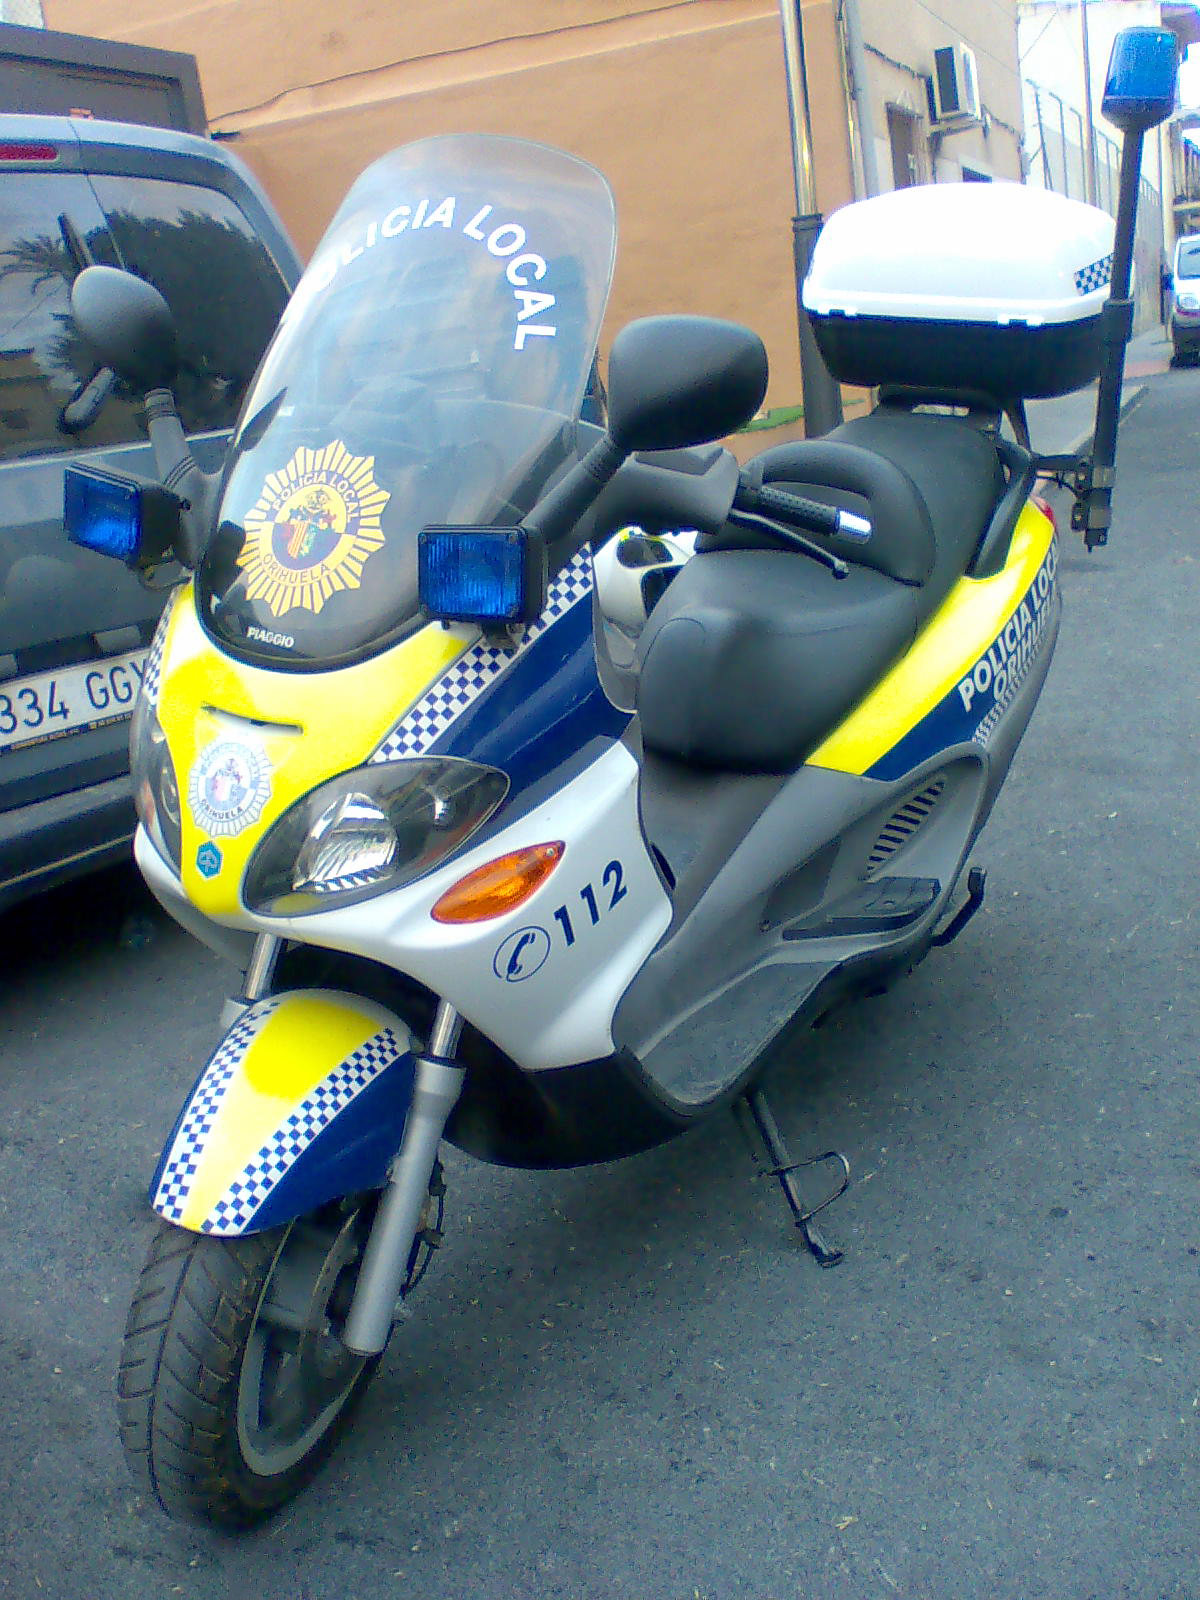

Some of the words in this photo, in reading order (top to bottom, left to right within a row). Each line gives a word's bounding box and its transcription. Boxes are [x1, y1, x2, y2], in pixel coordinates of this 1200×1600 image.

[300, 196, 456, 293] OLICIA
[462, 204, 557, 350] LOCAL
[272, 471, 327, 511] POLICIA
[329, 473, 360, 523] LOCAL
[262, 553, 332, 584] ORIHUELA
[246, 625, 295, 648] PIAGGIO
[958, 600, 1032, 713] POLICIA
[553, 860, 628, 946] 112
